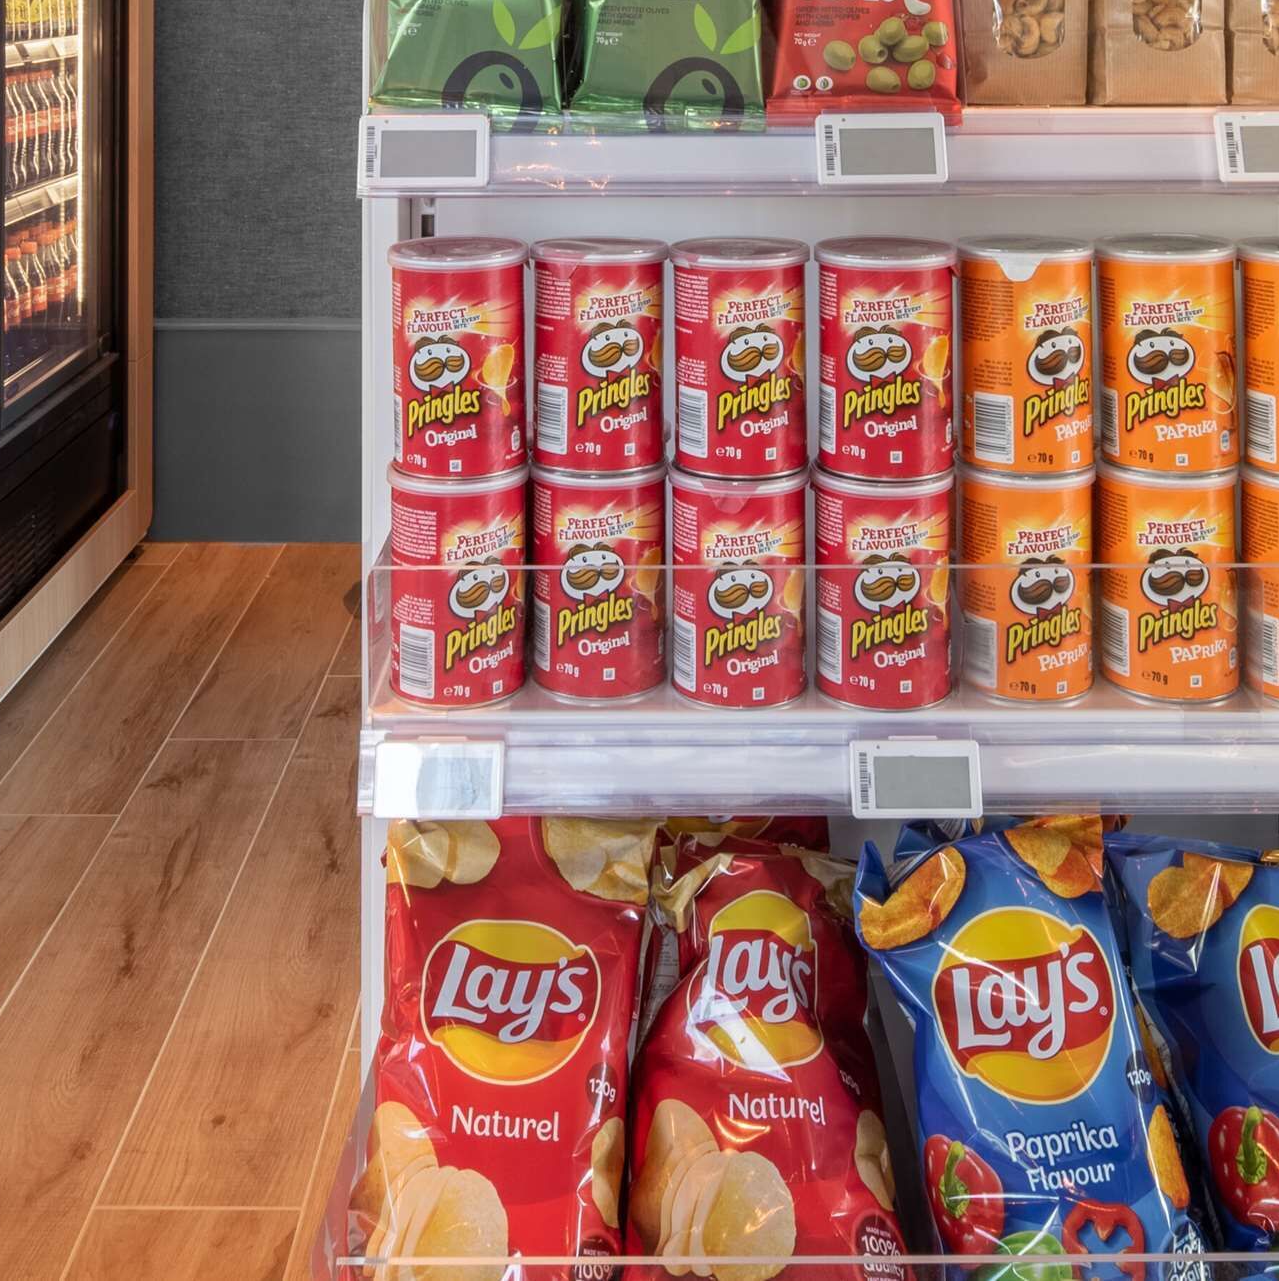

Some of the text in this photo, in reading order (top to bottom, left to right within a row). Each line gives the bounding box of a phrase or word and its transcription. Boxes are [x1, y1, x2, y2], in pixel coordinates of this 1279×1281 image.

[718, 310, 769, 325] FLAVOUR
[728, 295, 782, 313] PERFECT
[1125, 313, 1176, 326] FLAVOUR
[1133, 300, 1190, 315] PERFECT
[408, 386, 480, 437] Pringles
[577, 369, 650, 427] Pringles
[718, 373, 791, 430] Pringles
[844, 377, 920, 428] Pringles
[1025, 376, 1089, 436] Pringles
[1126, 377, 1205, 431] Pringles
[425, 424, 477, 446] Original
[600, 408, 647, 433] Original
[740, 412, 789, 437] Original
[864, 416, 917, 438] Original
[1154, 420, 1217, 441] PAPRIKA
[559, 529, 608, 541] FLAVOUR
[567, 514, 622, 529] PERFECT
[558, 593, 633, 645] Pringles
[851, 605, 928, 658] Pringles
[1006, 606, 1081, 662] Pringles
[1139, 597, 1217, 652] Pringles
[445, 604, 515, 670] Pringles
[578, 632, 629, 655] Original
[705, 609, 781, 665] Pringles
[1170, 638, 1227, 663] PAPRIKA
[470, 642, 513, 674] Original
[727, 650, 778, 675] Original
[874, 644, 926, 668] Original
[432, 943, 588, 1045] Lay's
[708, 934, 813, 1024] Lay's
[952, 944, 1099, 1060] Lay's
[451, 1106, 560, 1142] Naturel
[728, 1092, 826, 1126] Naturel
[1007, 1122, 1119, 1164] Paprika
[1026, 1161, 1116, 1193] Flavour
